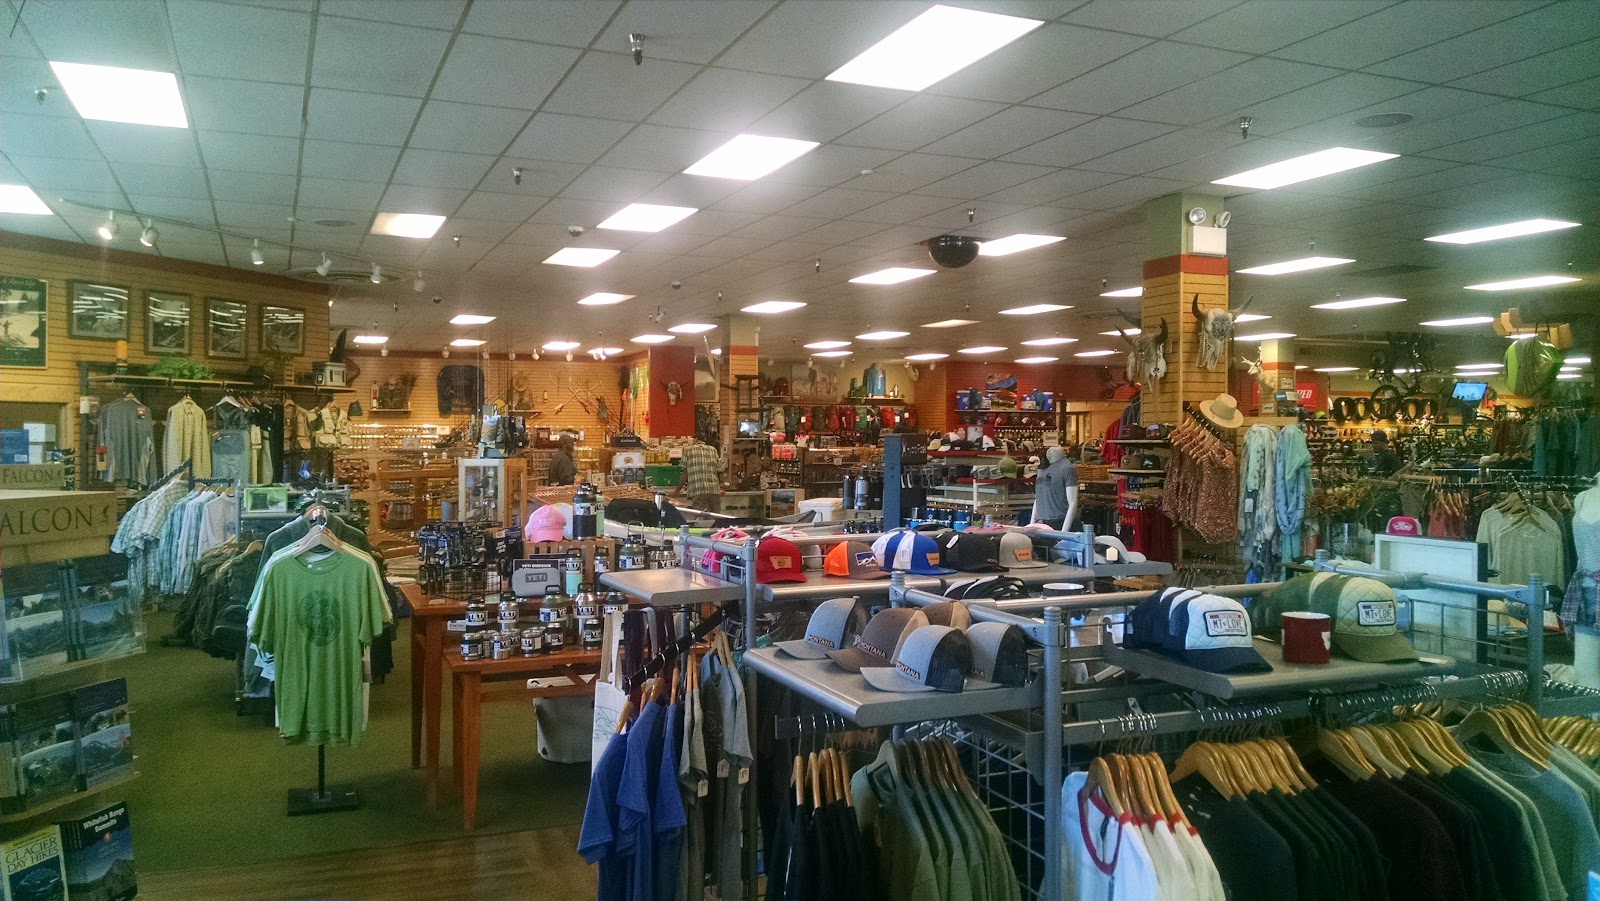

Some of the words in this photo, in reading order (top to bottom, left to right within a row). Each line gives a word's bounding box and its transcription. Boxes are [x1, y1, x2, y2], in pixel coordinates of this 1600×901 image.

[3, 468, 54, 483] FALCON
[0, 504, 93, 536] ALCON
[1212, 619, 1223, 629] MT
[1227, 619, 1243, 628] LOVE
[1364, 609, 1374, 619] MT
[6, 837, 58, 863] GLACIER
[8, 860, 27, 873] DAY
[31, 848, 59, 862] HIKES
